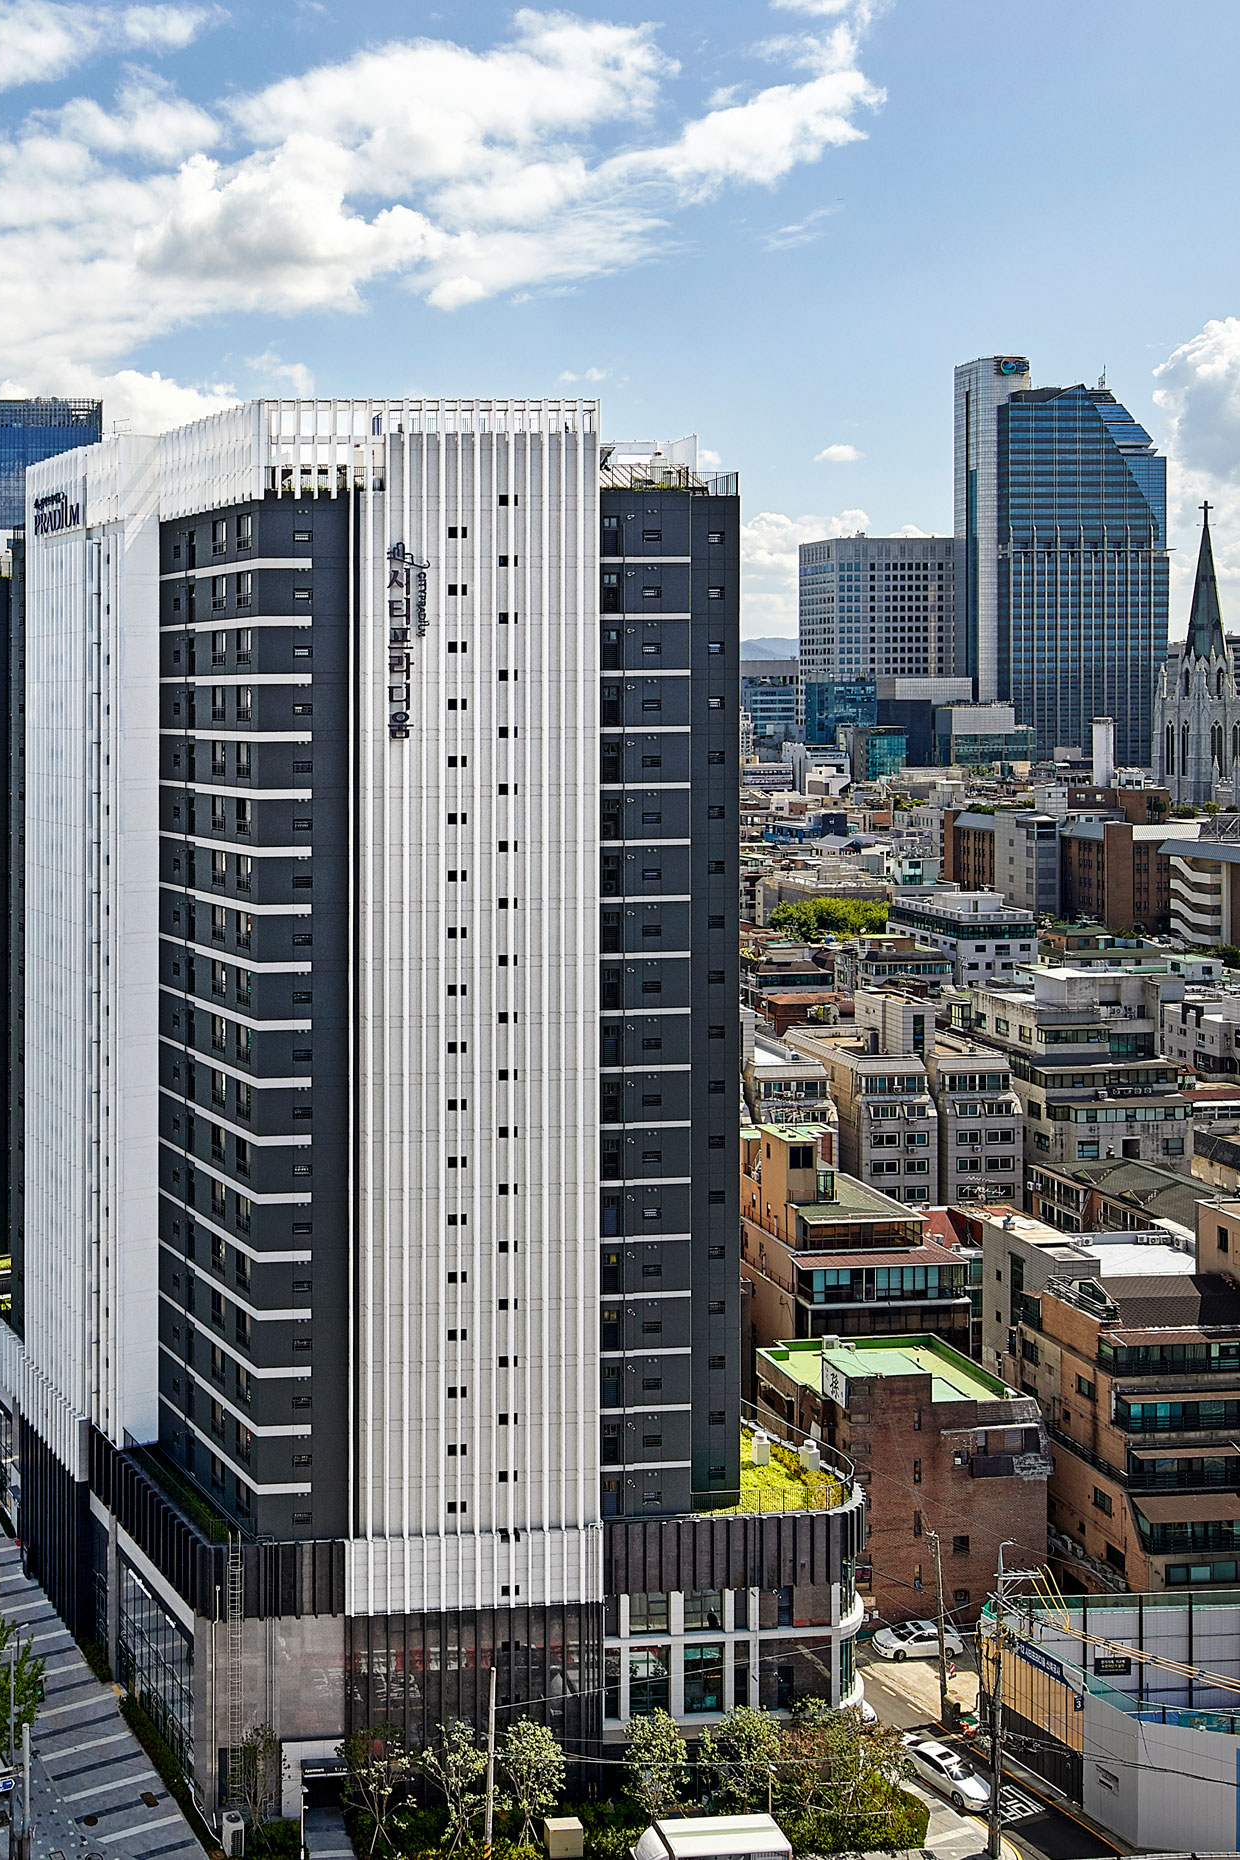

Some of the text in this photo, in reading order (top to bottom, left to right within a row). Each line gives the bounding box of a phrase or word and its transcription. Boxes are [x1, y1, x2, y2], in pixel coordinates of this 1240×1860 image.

[34, 495, 80, 536] PRADIUM
[387, 568, 415, 739] 시티프라디움
[1076, 1700, 1082, 1709] 3
